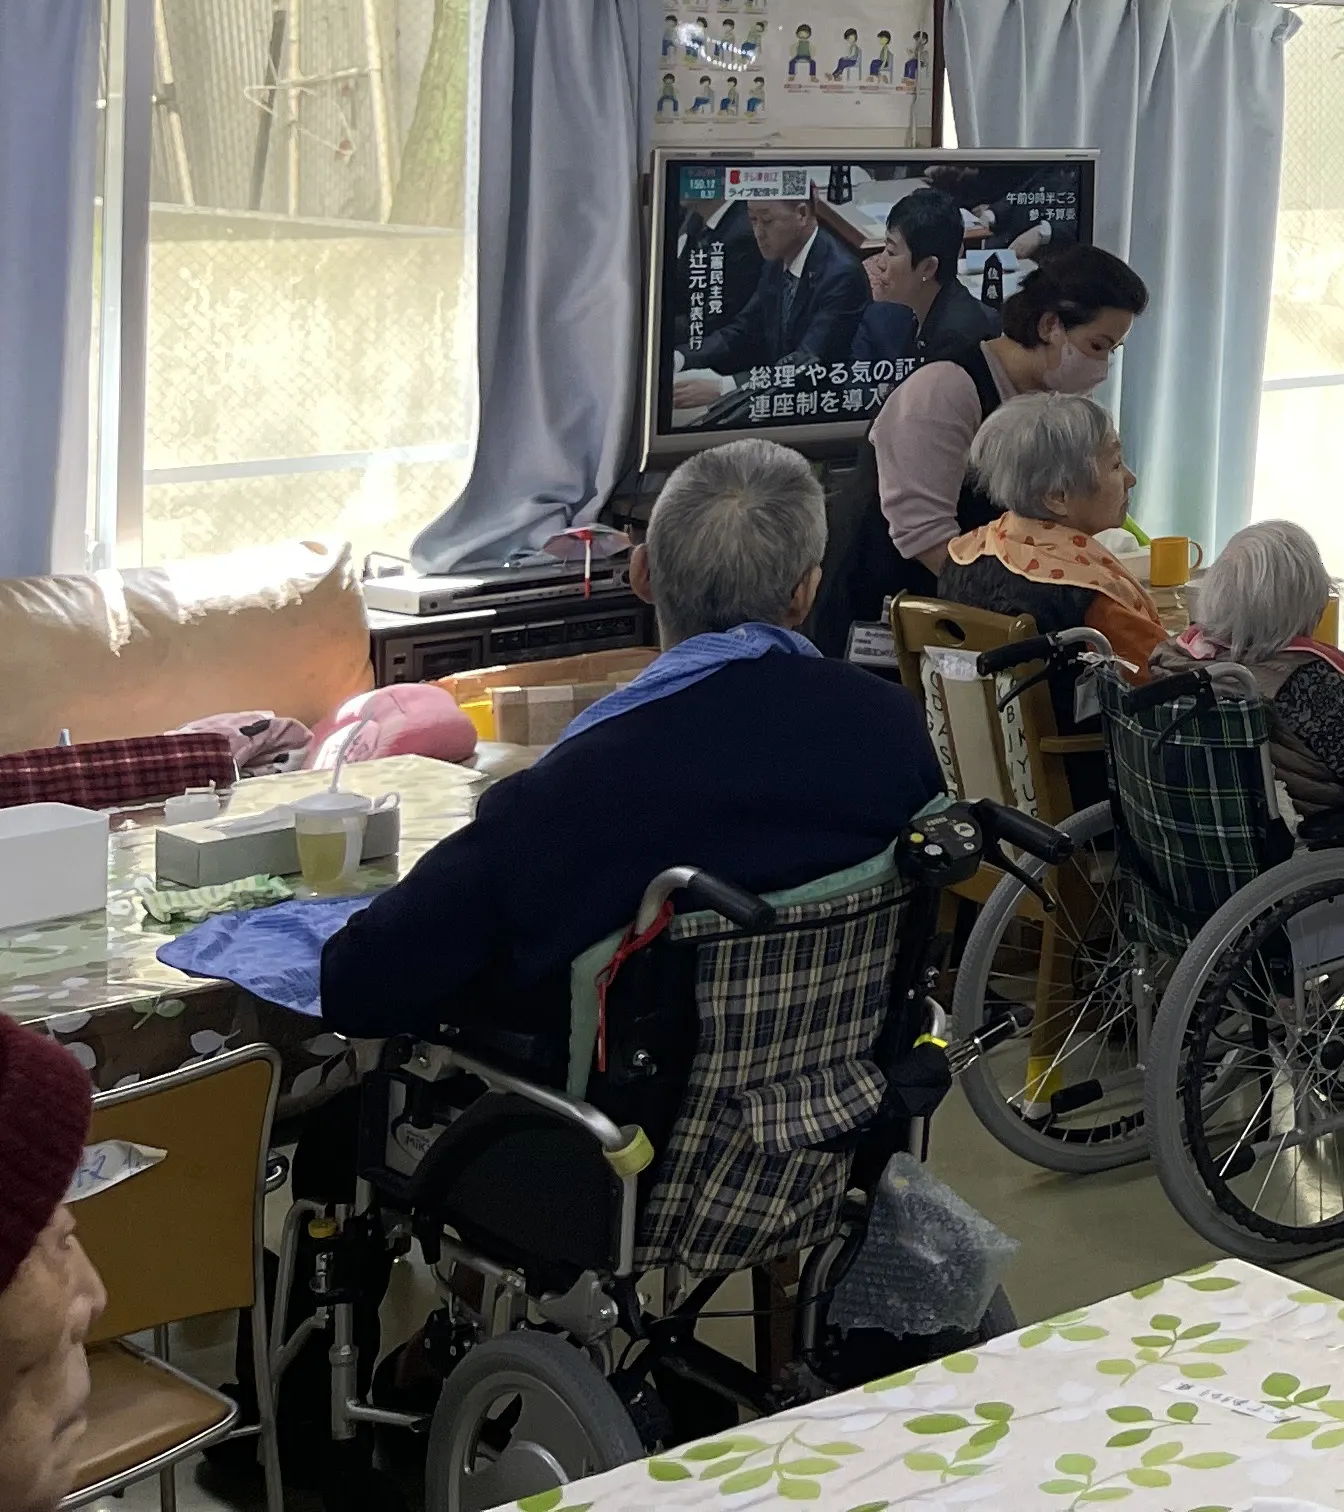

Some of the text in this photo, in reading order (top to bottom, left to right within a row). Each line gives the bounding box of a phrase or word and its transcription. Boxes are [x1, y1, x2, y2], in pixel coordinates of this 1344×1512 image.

[1006, 192, 1076, 205] 午前9時半ごろ
[708, 240, 725, 315] 立憲民主党
